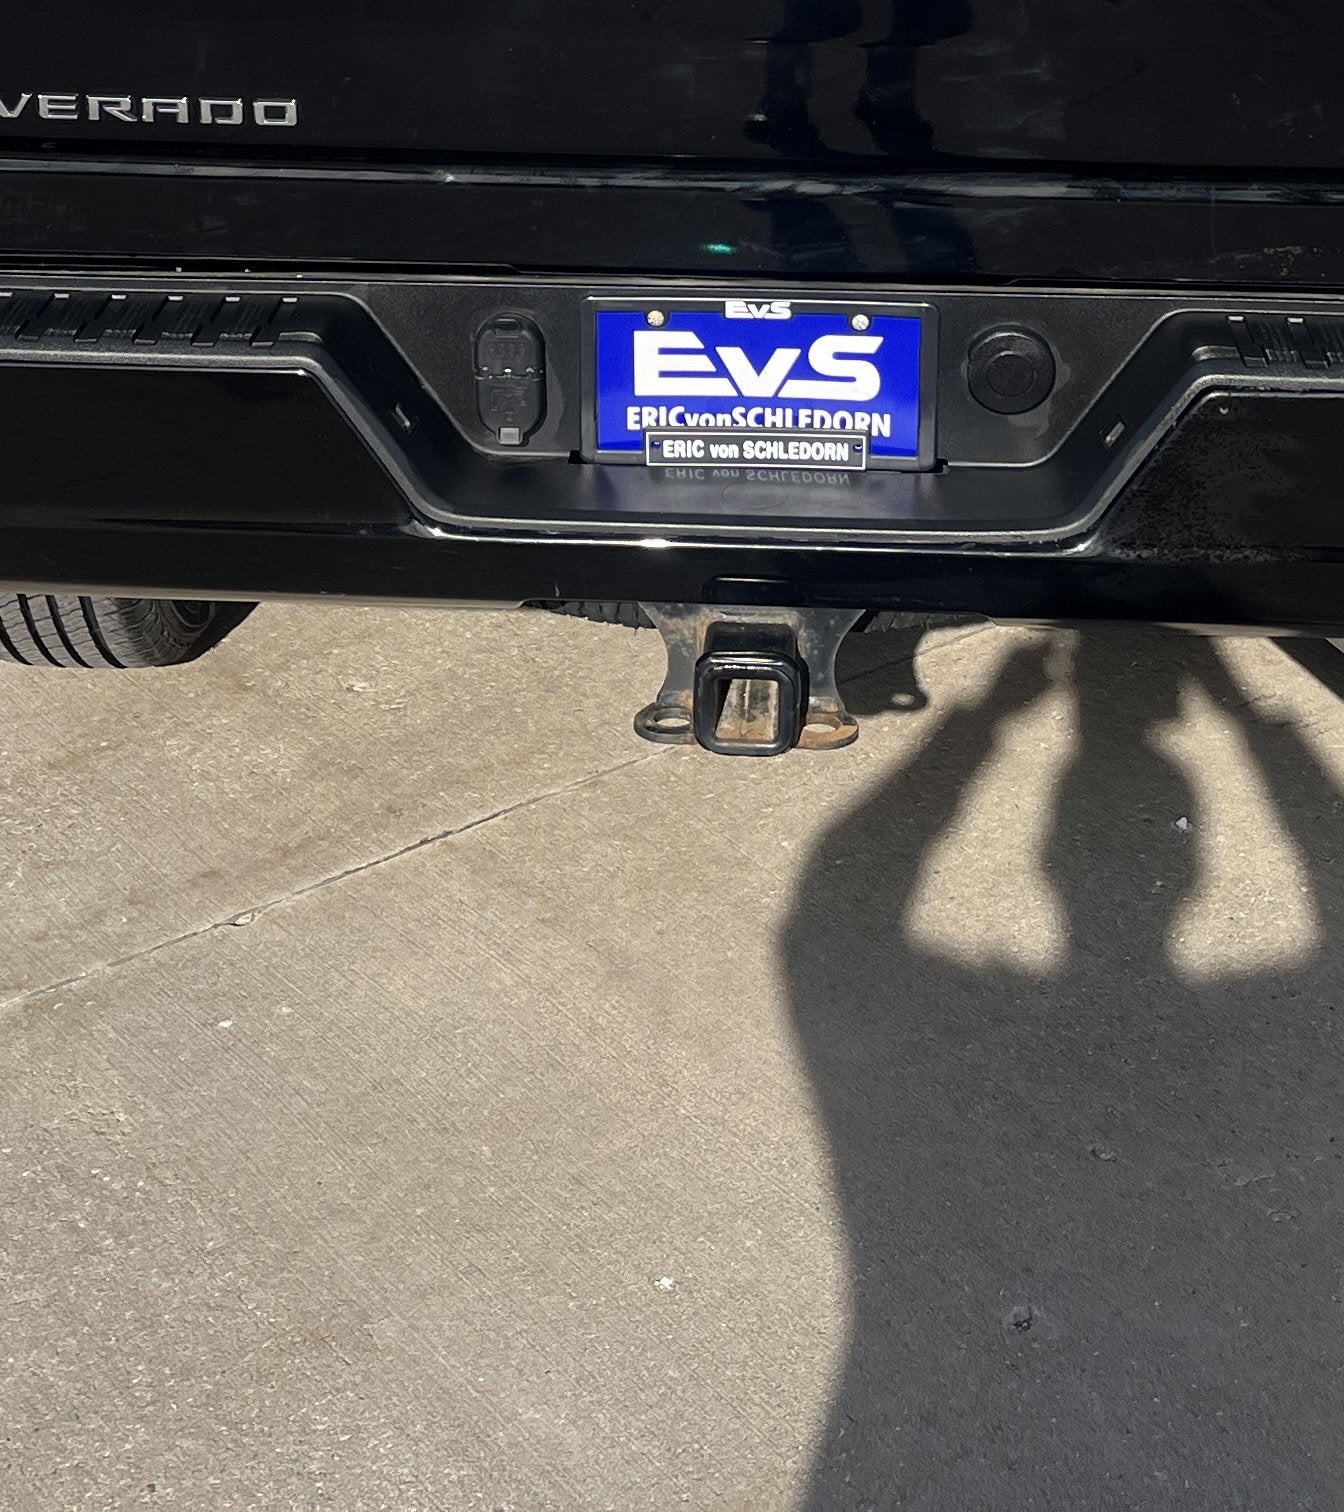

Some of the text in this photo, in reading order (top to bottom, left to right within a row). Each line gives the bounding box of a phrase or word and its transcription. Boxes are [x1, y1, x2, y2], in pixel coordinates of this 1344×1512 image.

[724, 300, 792, 319] EvS
[633, 329, 884, 402] EvS
[662, 439, 849, 462] ERIC von SCHLEDORN
